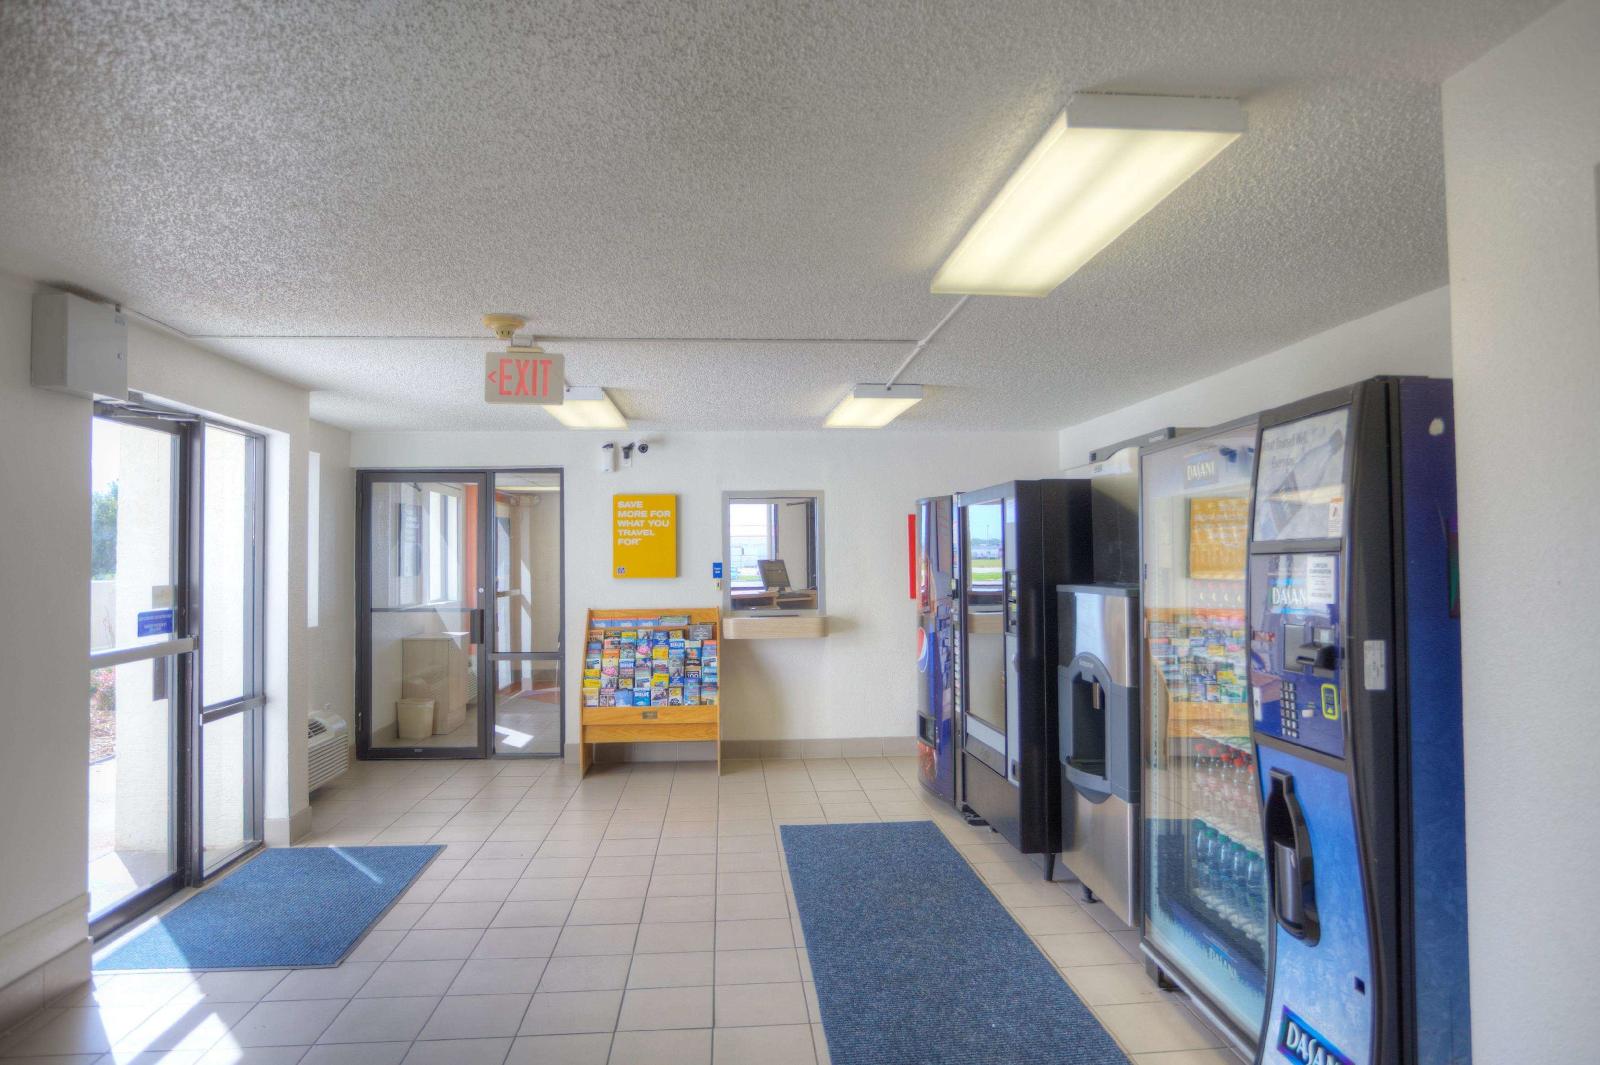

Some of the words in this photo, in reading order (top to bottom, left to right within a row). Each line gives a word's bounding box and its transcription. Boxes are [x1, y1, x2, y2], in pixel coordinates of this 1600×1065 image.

[499, 358, 553, 397] EXIT
[617, 500, 644, 509] SAVE
[617, 510, 648, 518] MORE
[650, 510, 671, 518] FOR
[617, 519, 645, 528] WHAT
[648, 519, 671, 528] YOU
[617, 529, 656, 537] TRAVEL
[1272, 586, 1307, 606] DASAN
